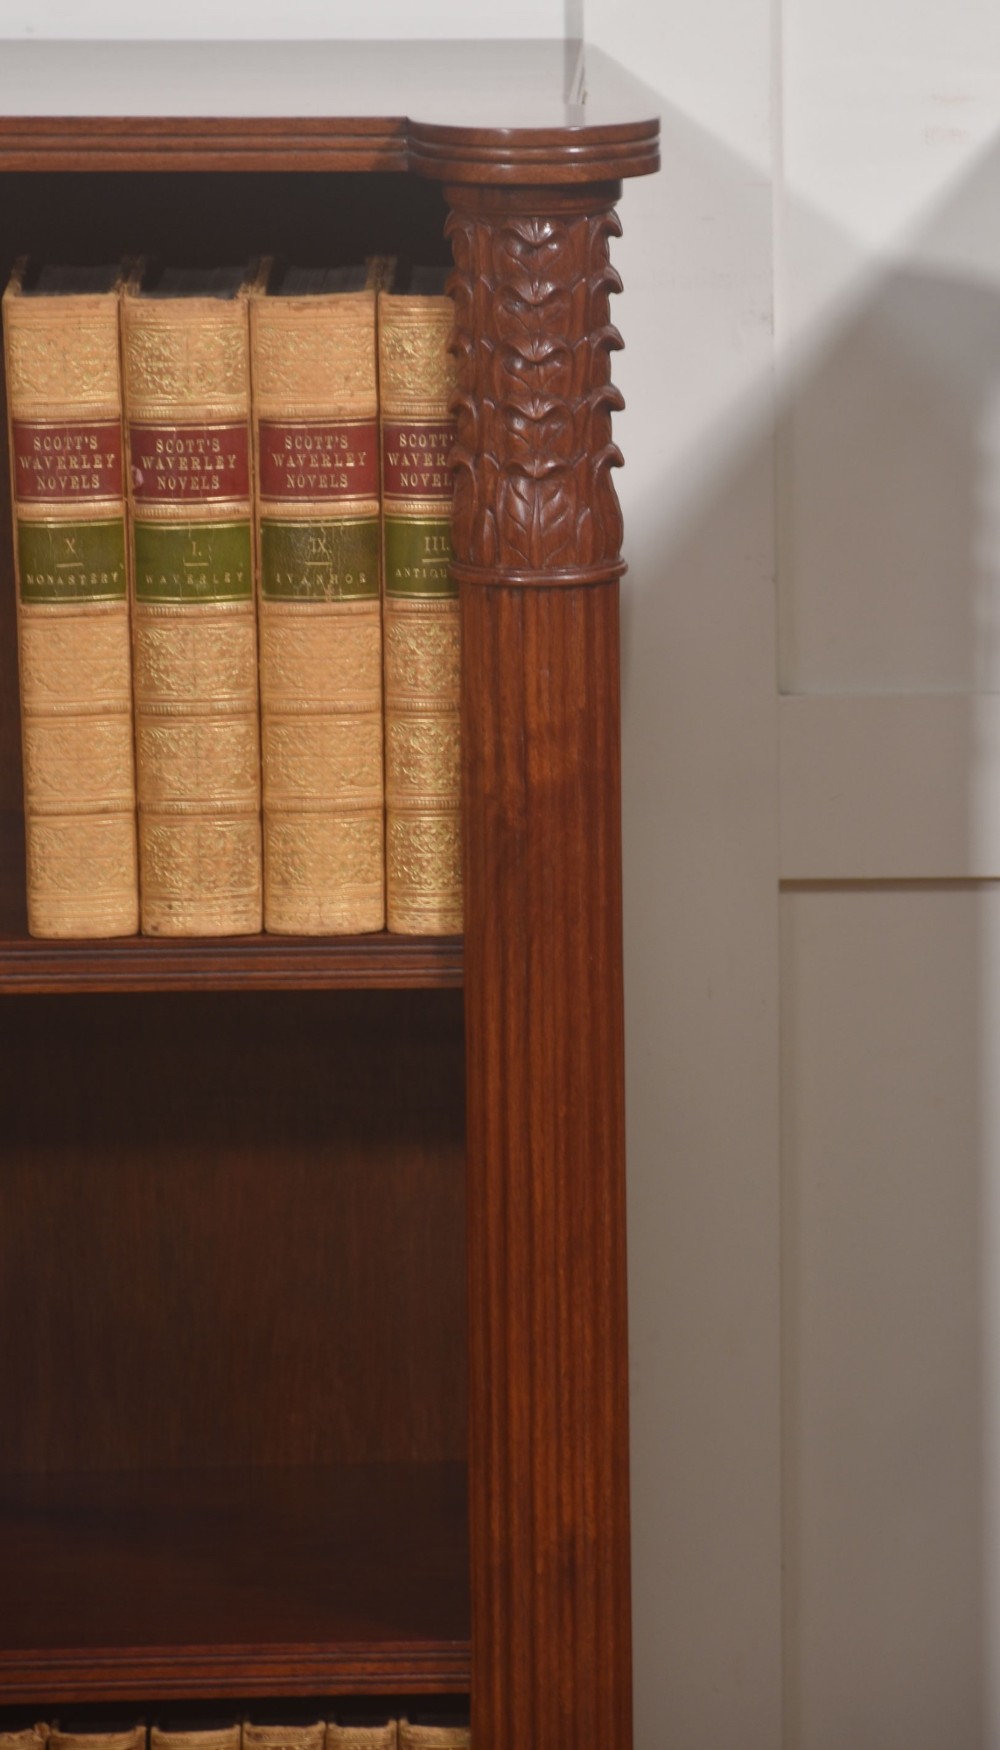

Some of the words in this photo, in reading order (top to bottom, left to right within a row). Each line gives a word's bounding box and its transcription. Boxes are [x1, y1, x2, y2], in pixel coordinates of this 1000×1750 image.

[33, 435, 98, 451] SCOTT'S
[156, 438, 220, 453] SCOTT'S
[285, 434, 348, 449] SCOTT'S
[399, 433, 456, 447] SCOTT'
[19, 454, 115, 471] WAVERLEY
[142, 455, 236, 470] WAVERLEY
[272, 452, 366, 468] WAVERLEY
[387, 452, 447, 467] WAVER
[37, 474, 100, 490] NOVELS
[157, 475, 220, 490] NOVELS
[286, 473, 348, 488] NOVELS
[400, 472, 452, 487] NOVEL
[26, 571, 119, 585] MONASTERY
[145, 571, 243, 585] WAVERLEY
[276, 572, 366, 585] IVANHOE
[396, 567, 448, 579] ANTIQU
